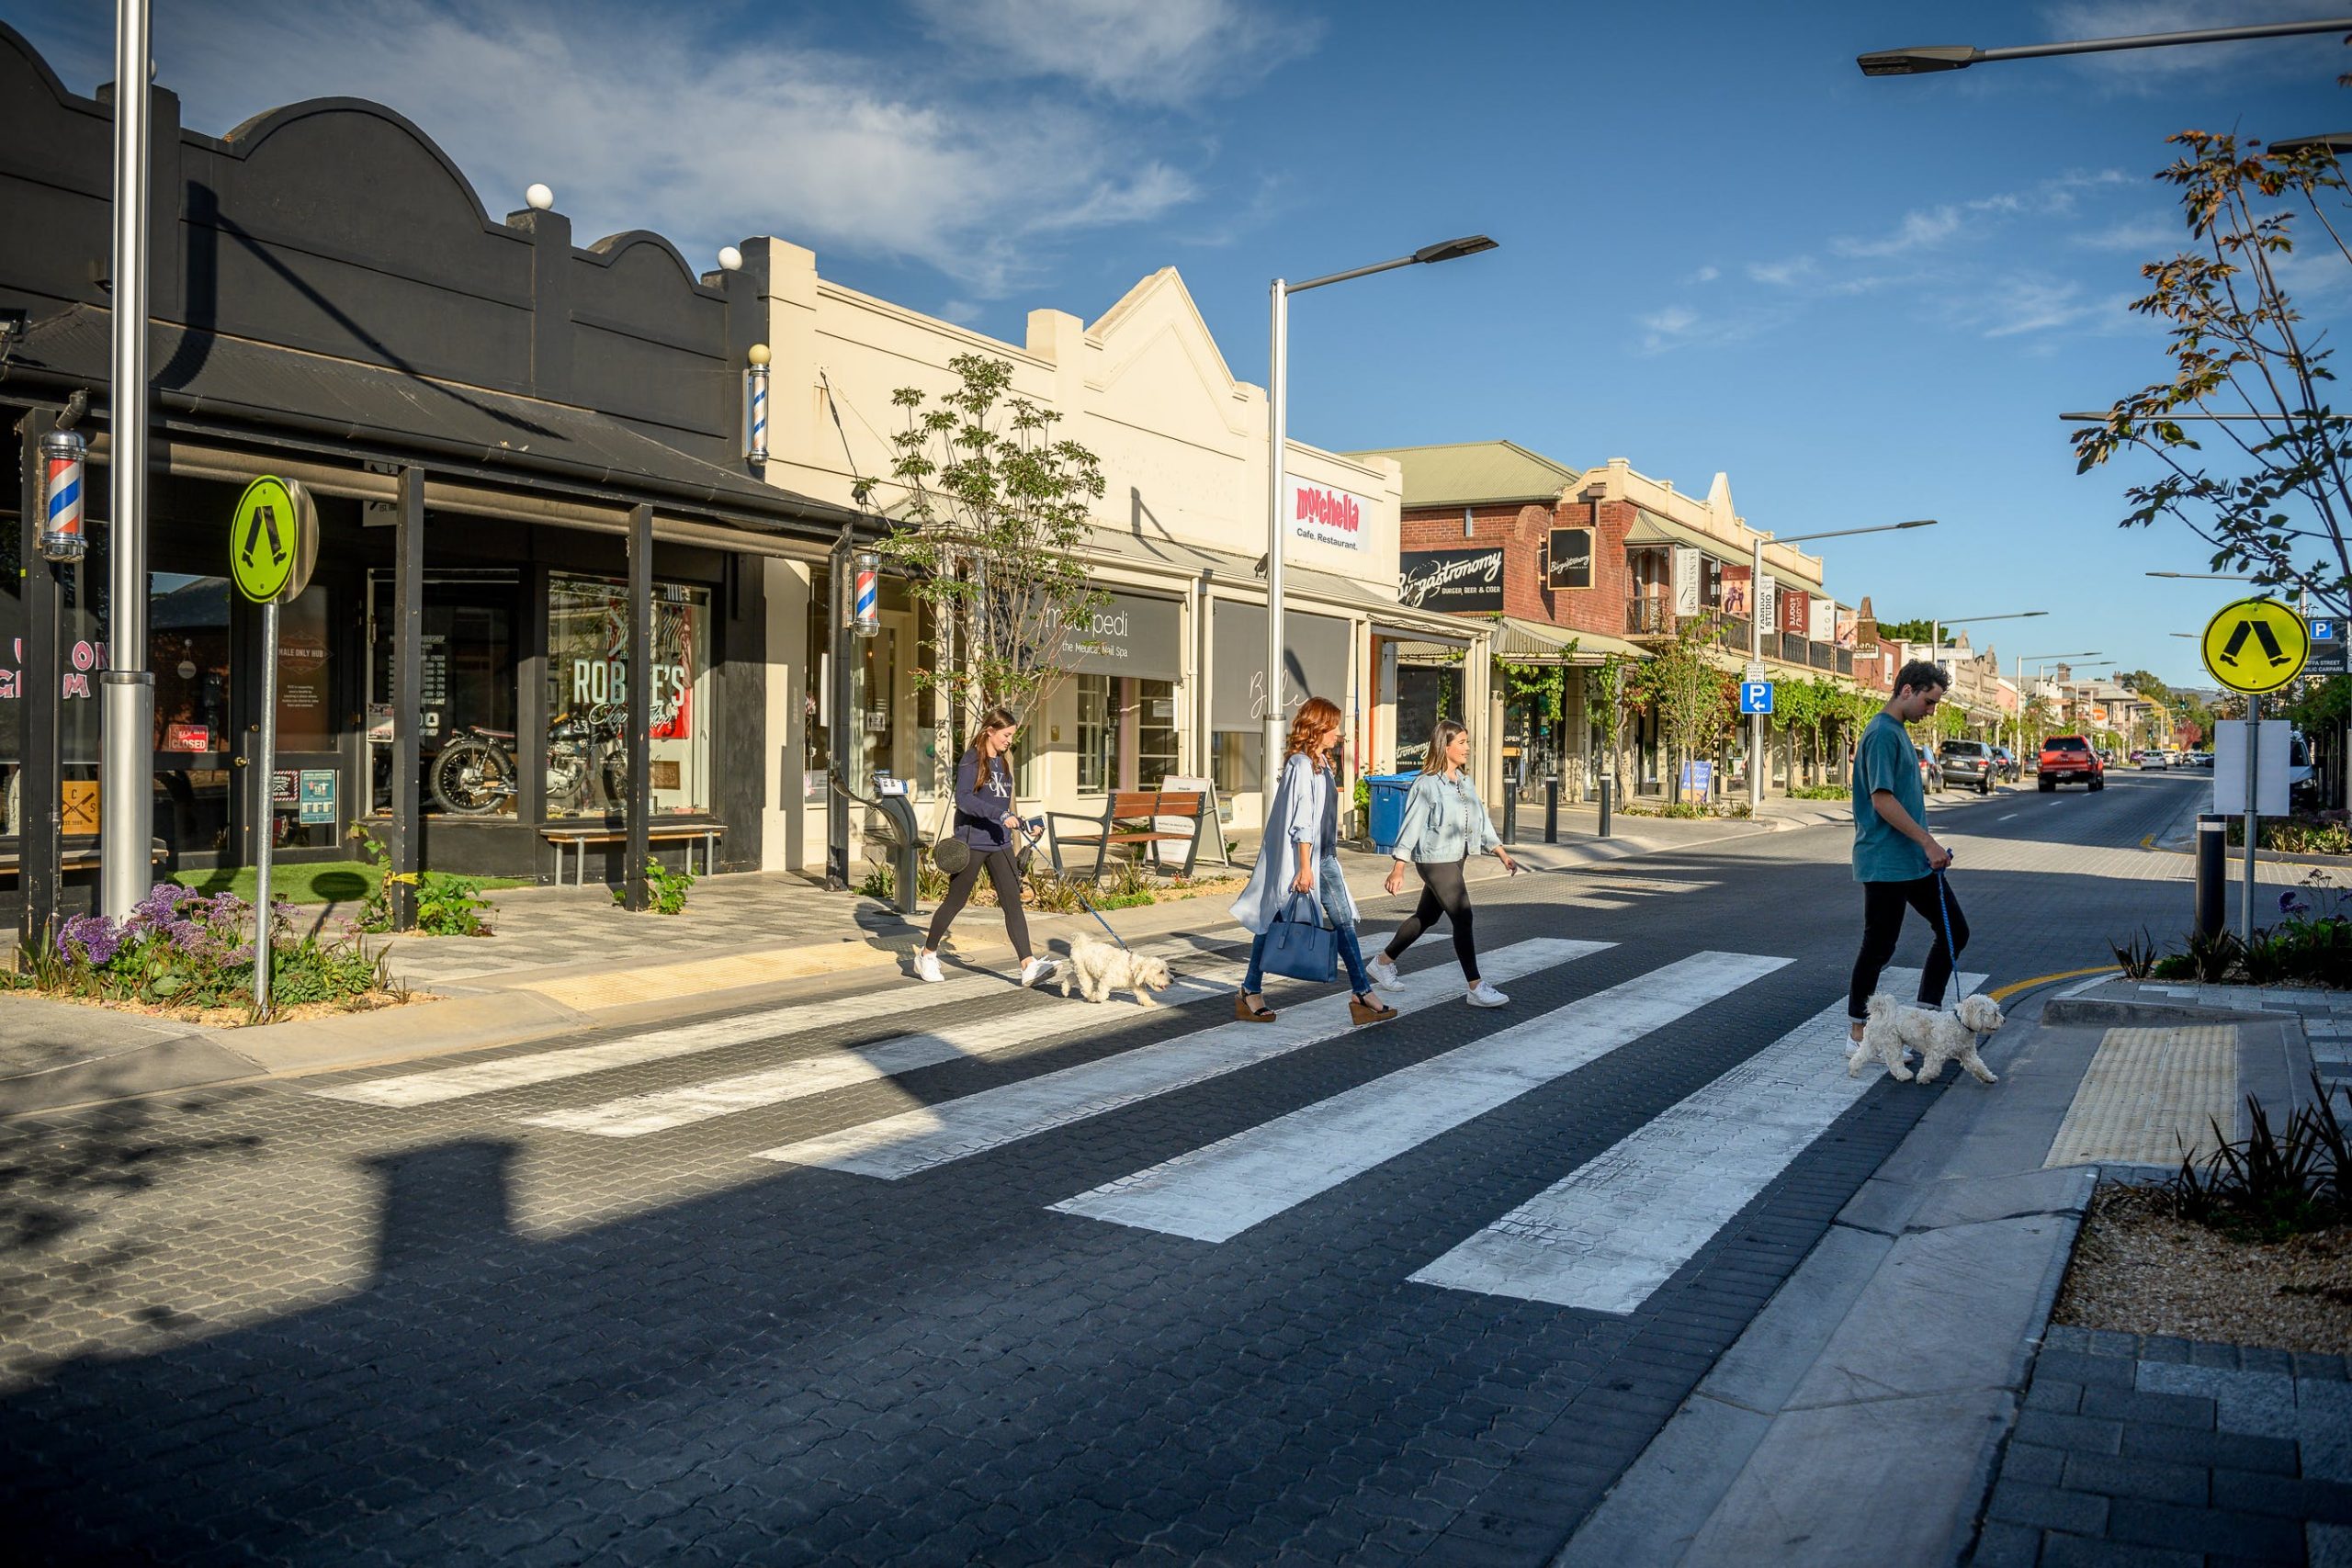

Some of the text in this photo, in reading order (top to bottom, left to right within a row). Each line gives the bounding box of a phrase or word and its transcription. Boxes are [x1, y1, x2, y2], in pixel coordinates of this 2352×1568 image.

[1296, 527, 1359, 551] Cafe. Restaurant.
[1398, 551, 1502, 609] Burgastronomy
[1442, 588, 1463, 596] BURGER,
[2316, 623, 2326, 637] P
[295, 649, 311, 658] ONLY
[1062, 640, 1073, 652] the
[1115, 646, 1128, 659] Spa
[574, 659, 684, 706] ROBE'S
[1749, 684, 1766, 705] P
[172, 739, 206, 750] CLOSED
[72, 789, 77, 799] C
[90, 803, 96, 813] S
